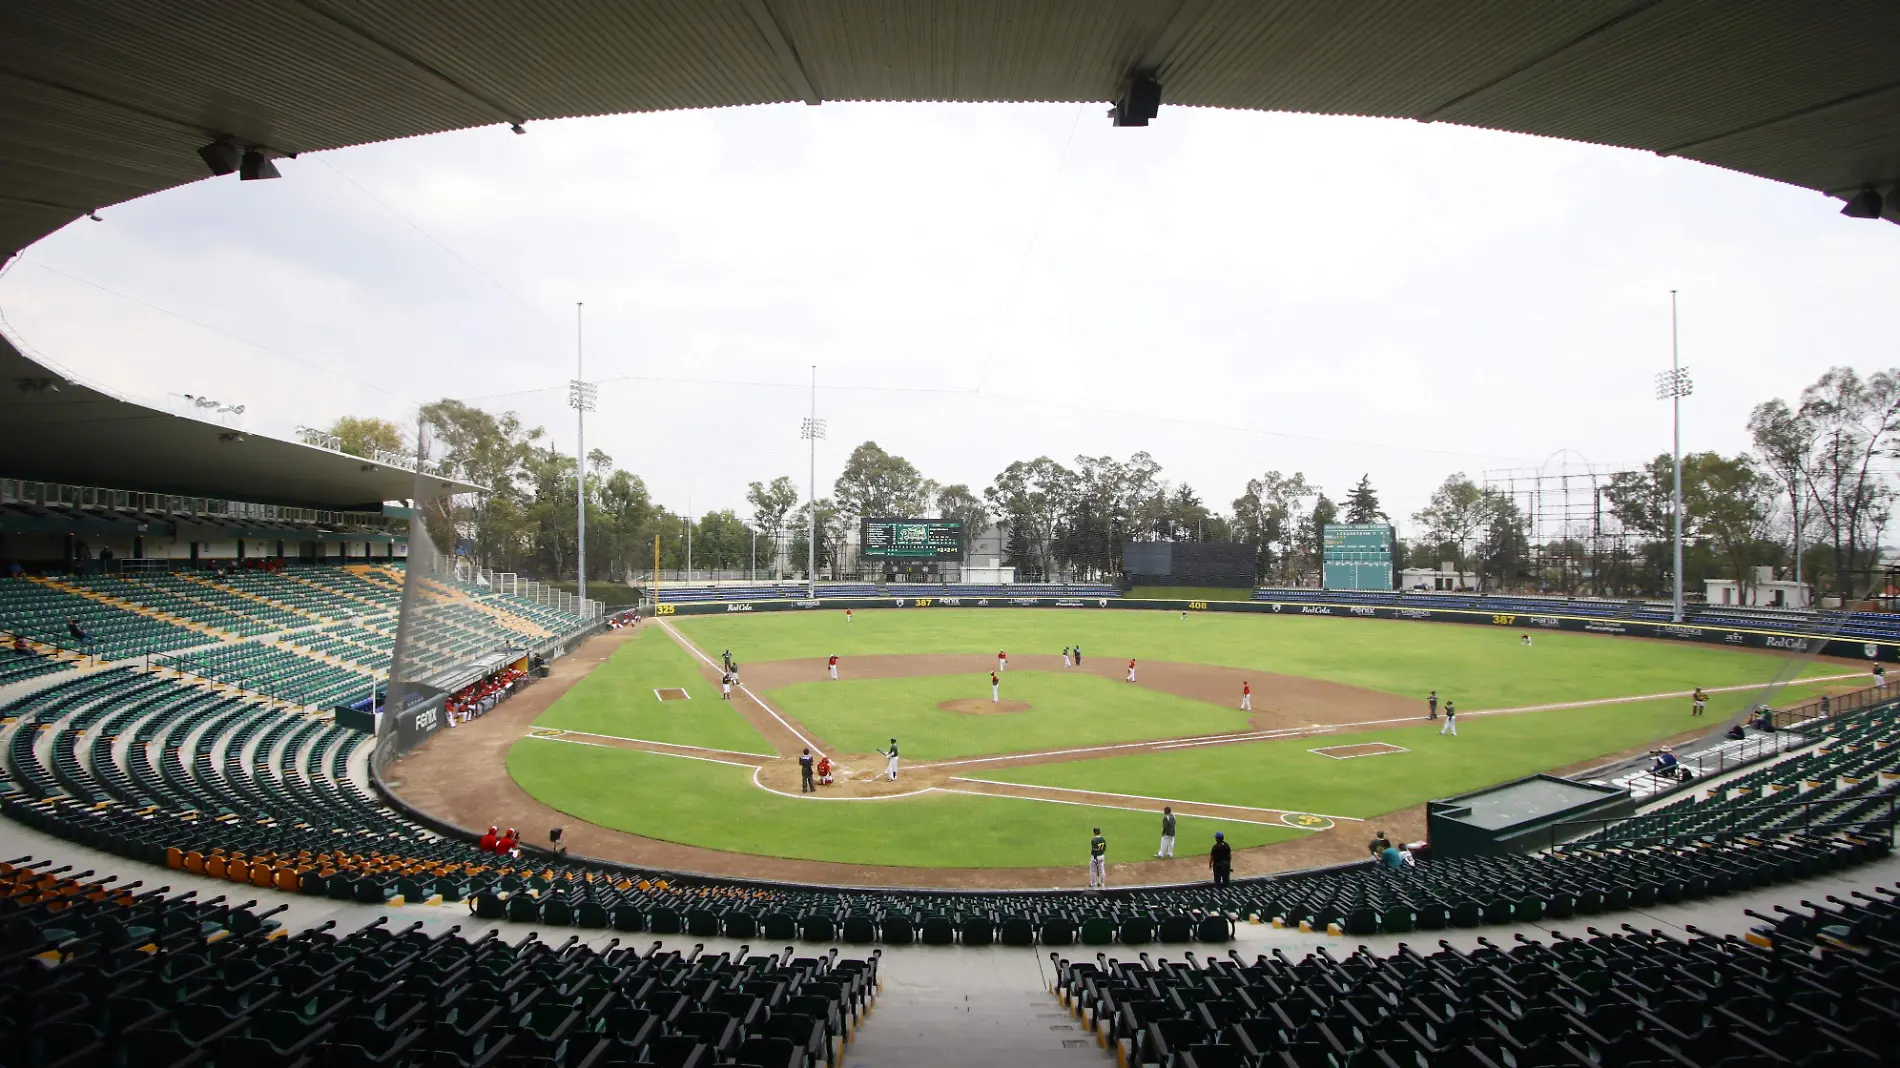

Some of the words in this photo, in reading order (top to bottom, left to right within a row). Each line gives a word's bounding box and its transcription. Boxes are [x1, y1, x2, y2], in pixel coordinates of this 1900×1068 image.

[915, 599, 932, 607] 387
[657, 605, 675, 615] 325
[1301, 605, 1315, 614] Red
[1314, 606, 1331, 614] Cola
[1492, 615, 1515, 625] 387
[1766, 636, 1785, 647] Red
[1784, 638, 1809, 649] Cola
